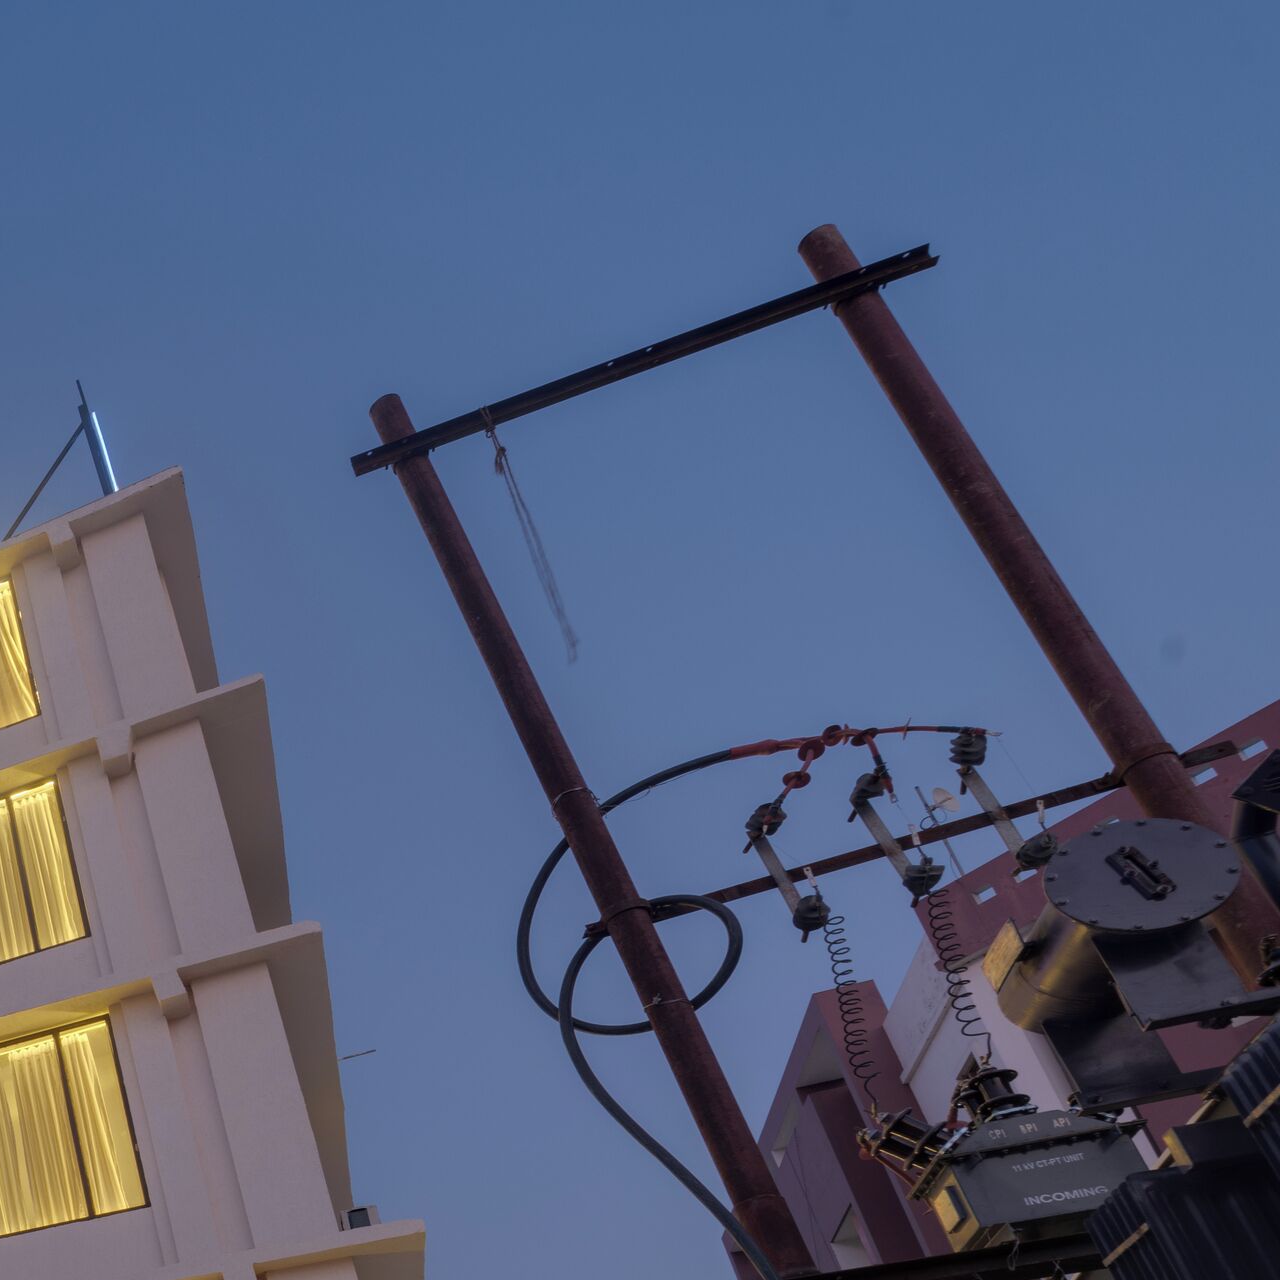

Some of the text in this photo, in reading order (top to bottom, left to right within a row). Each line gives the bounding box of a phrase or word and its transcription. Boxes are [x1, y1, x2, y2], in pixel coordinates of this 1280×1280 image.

[1052, 1117, 1071, 1128] API
[989, 1128, 1007, 1140] CPI
[1012, 1164, 1023, 1172] 11
[1063, 1152, 1085, 1163] UNIT
[1023, 1185, 1109, 1206] INCOMING
